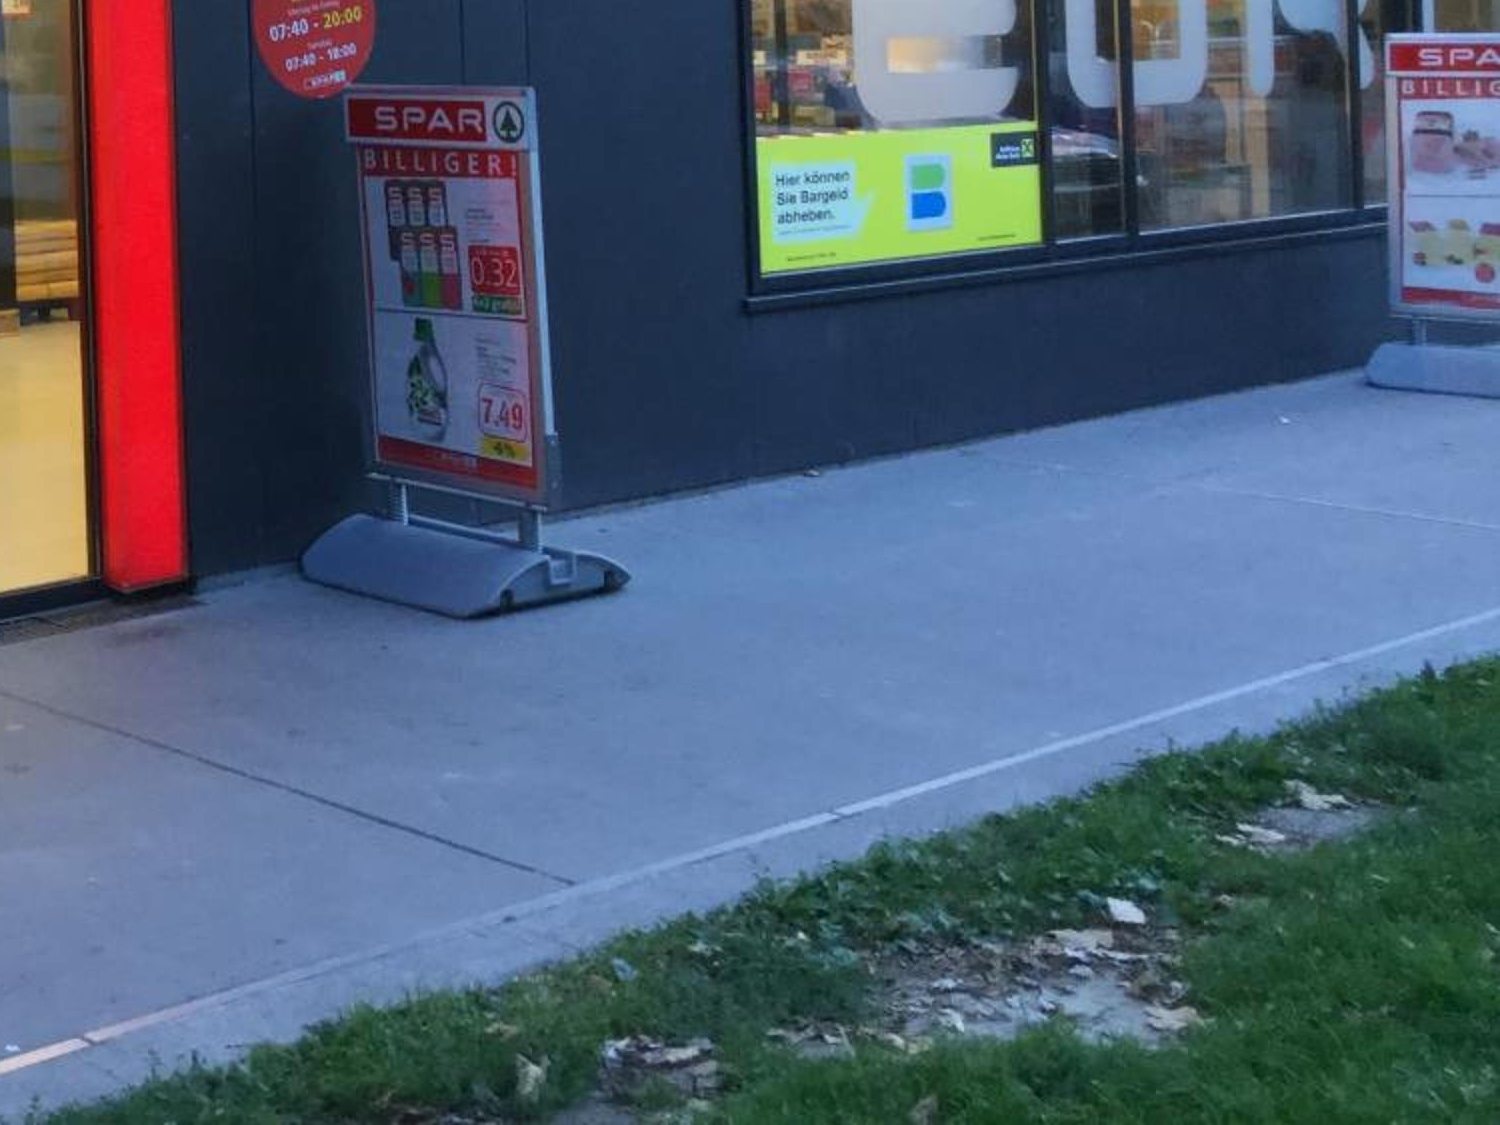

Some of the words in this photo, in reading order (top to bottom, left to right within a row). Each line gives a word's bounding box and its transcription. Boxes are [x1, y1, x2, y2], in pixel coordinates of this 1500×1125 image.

[268, 18, 309, 42] 07:40
[323, 5, 363, 29] 20:00
[374, 106, 485, 134] SPAR
[364, 148, 517, 175] BILLIGER!
[775, 169, 801, 188] Hier
[803, 167, 850, 185] können
[777, 191, 800, 206] Sie
[800, 188, 849, 206] Bargeld
[777, 208, 835, 225] abheben.
[470, 256, 517, 288] 0.32
[481, 397, 523, 430] 7.49
